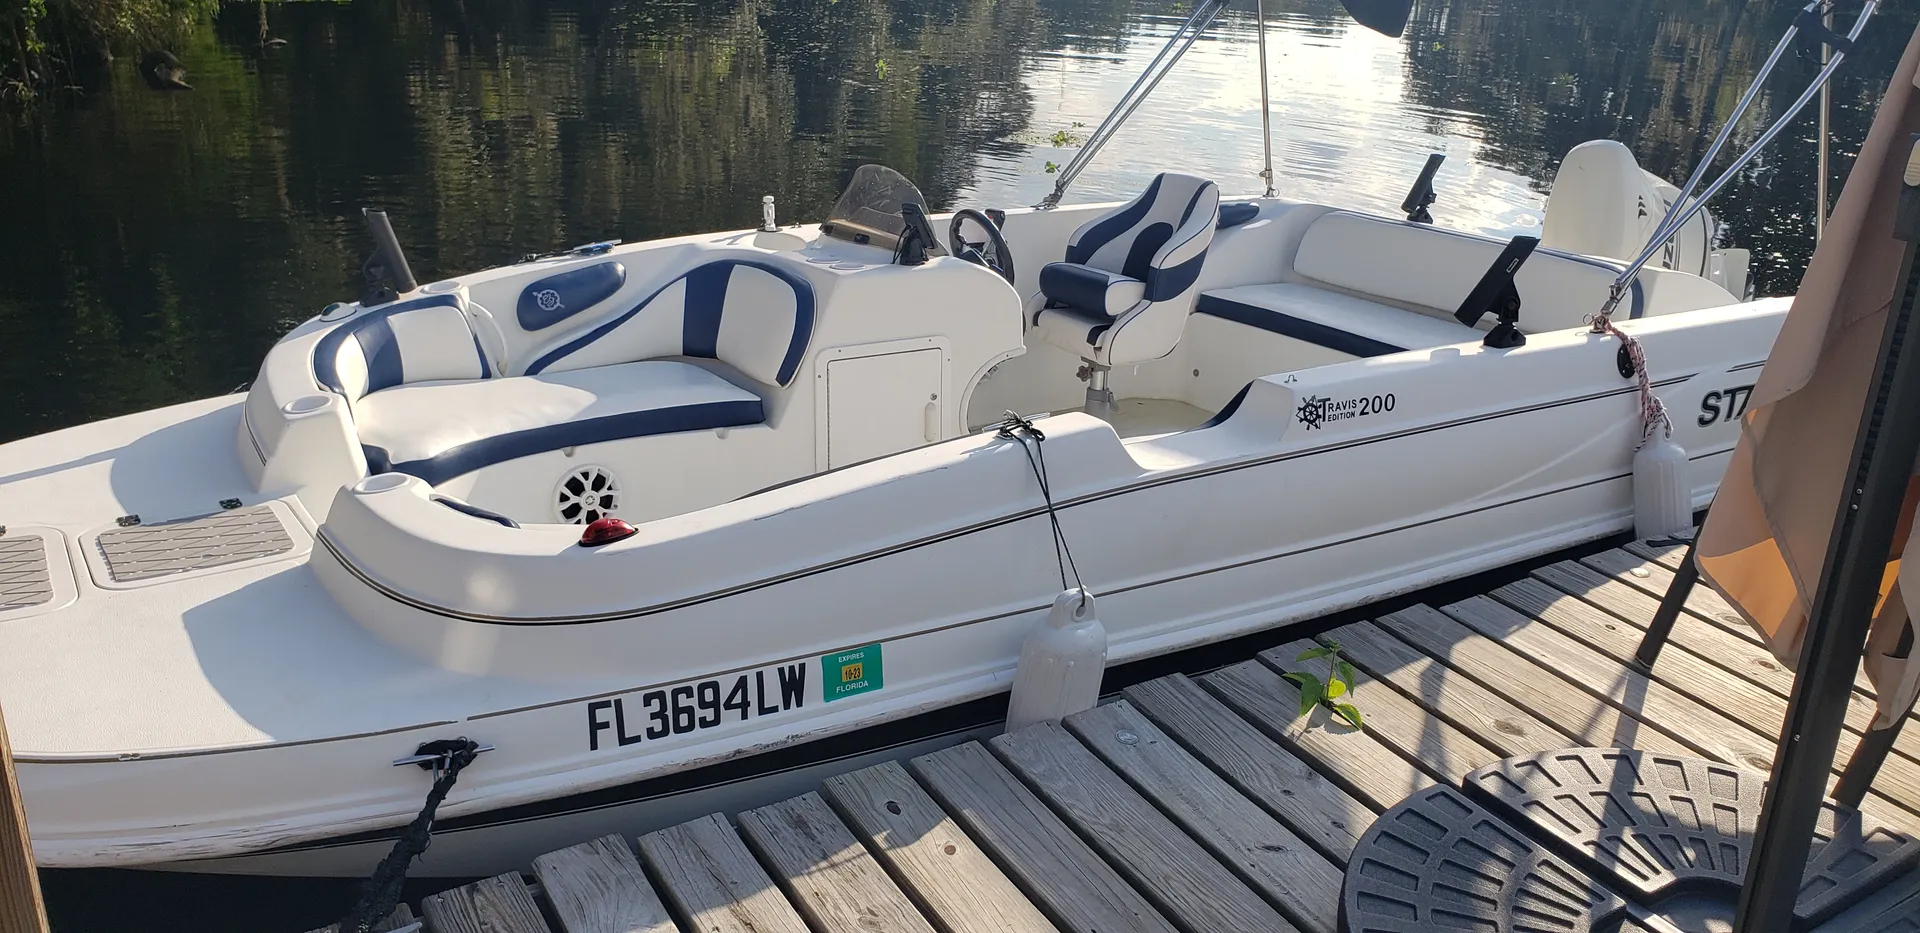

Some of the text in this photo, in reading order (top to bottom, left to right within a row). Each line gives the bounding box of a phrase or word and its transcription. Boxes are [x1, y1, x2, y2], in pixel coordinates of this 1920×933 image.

[1317, 397, 1358, 422] TRAVIS
[1358, 393, 1396, 416] 200
[1327, 411, 1356, 422] EDITION
[838, 652, 864, 662] EXPIRES
[845, 667, 860, 680] 10-23
[836, 680, 869, 693] FLORIDA
